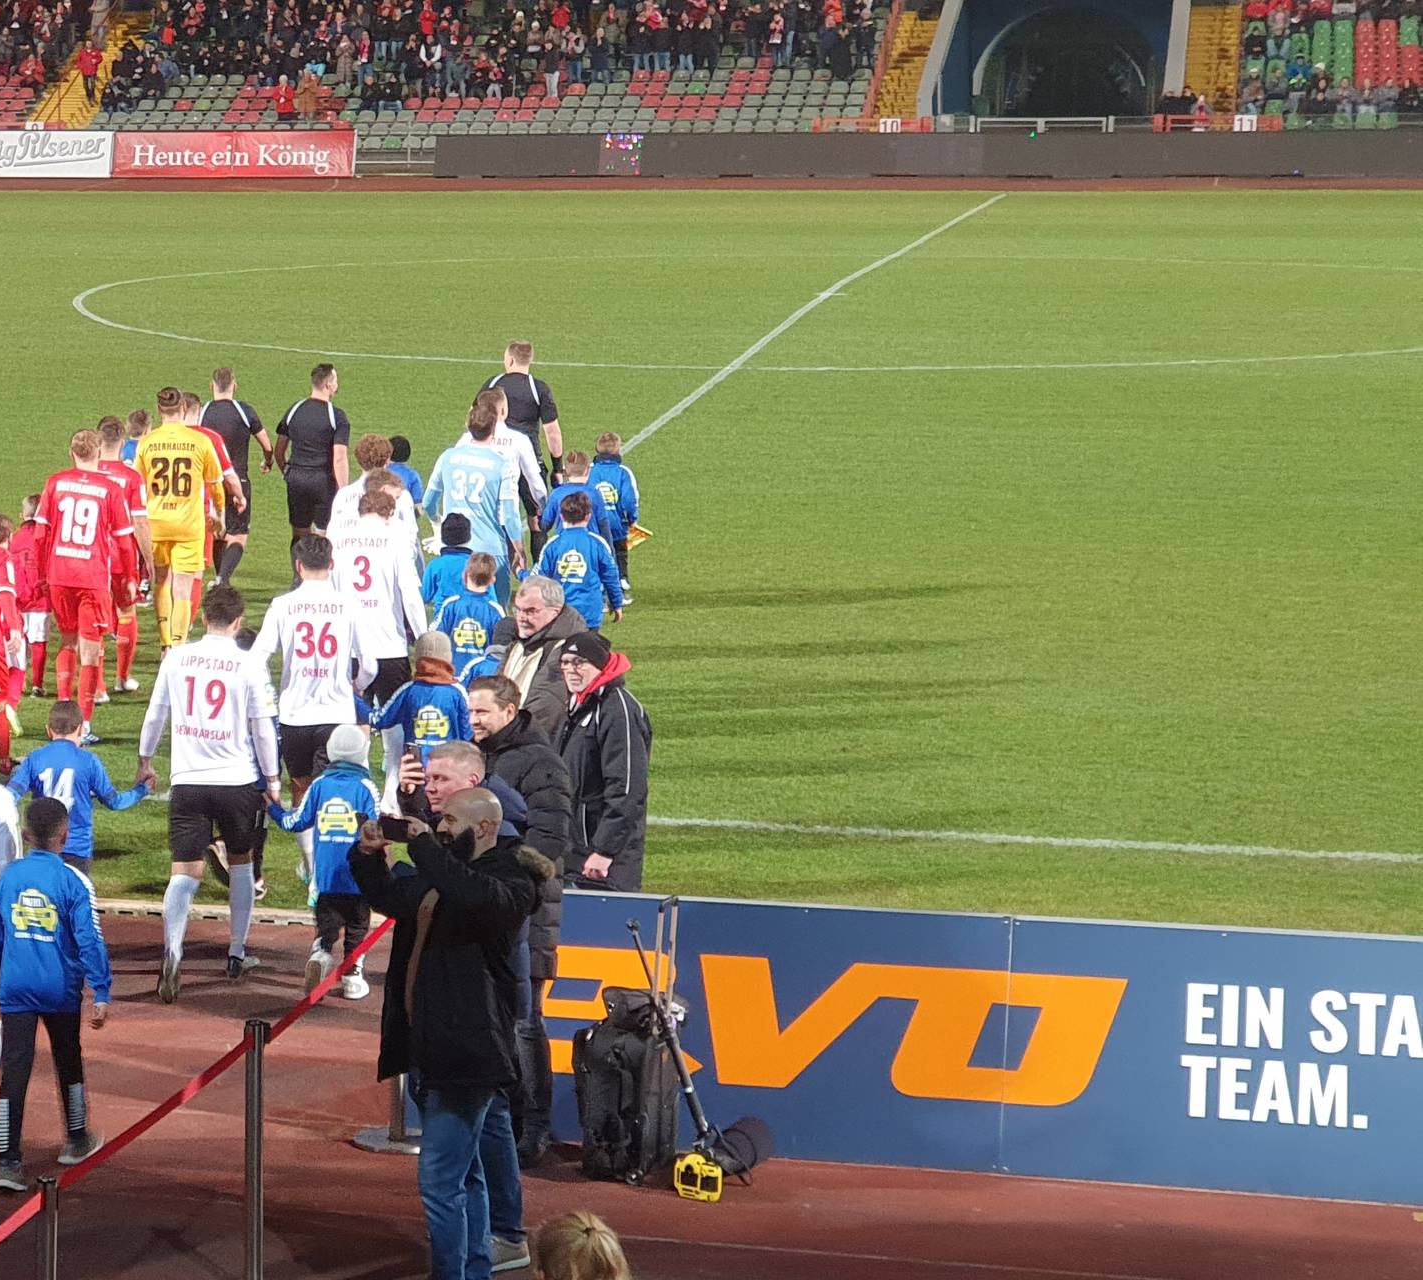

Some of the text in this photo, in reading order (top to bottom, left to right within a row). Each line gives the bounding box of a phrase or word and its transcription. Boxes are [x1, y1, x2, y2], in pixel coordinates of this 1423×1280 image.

[881, 120, 898, 131] 10
[17, 132, 106, 160] Pilsener
[132, 144, 330, 175] Heute ein König
[151, 457, 192, 497] 36
[450, 469, 486, 504] 32
[58, 497, 99, 546] 19
[353, 555, 372, 592] 3
[288, 603, 344, 616] LIPPSTADT
[295, 621, 338, 659] 36
[180, 655, 241, 673] LIPPSTADT
[184, 675, 227, 720] 19
[38, 767, 75, 815] 14
[1185, 982, 1423, 1059] EIN STA
[1180, 1054, 1369, 1130] TEAM.
